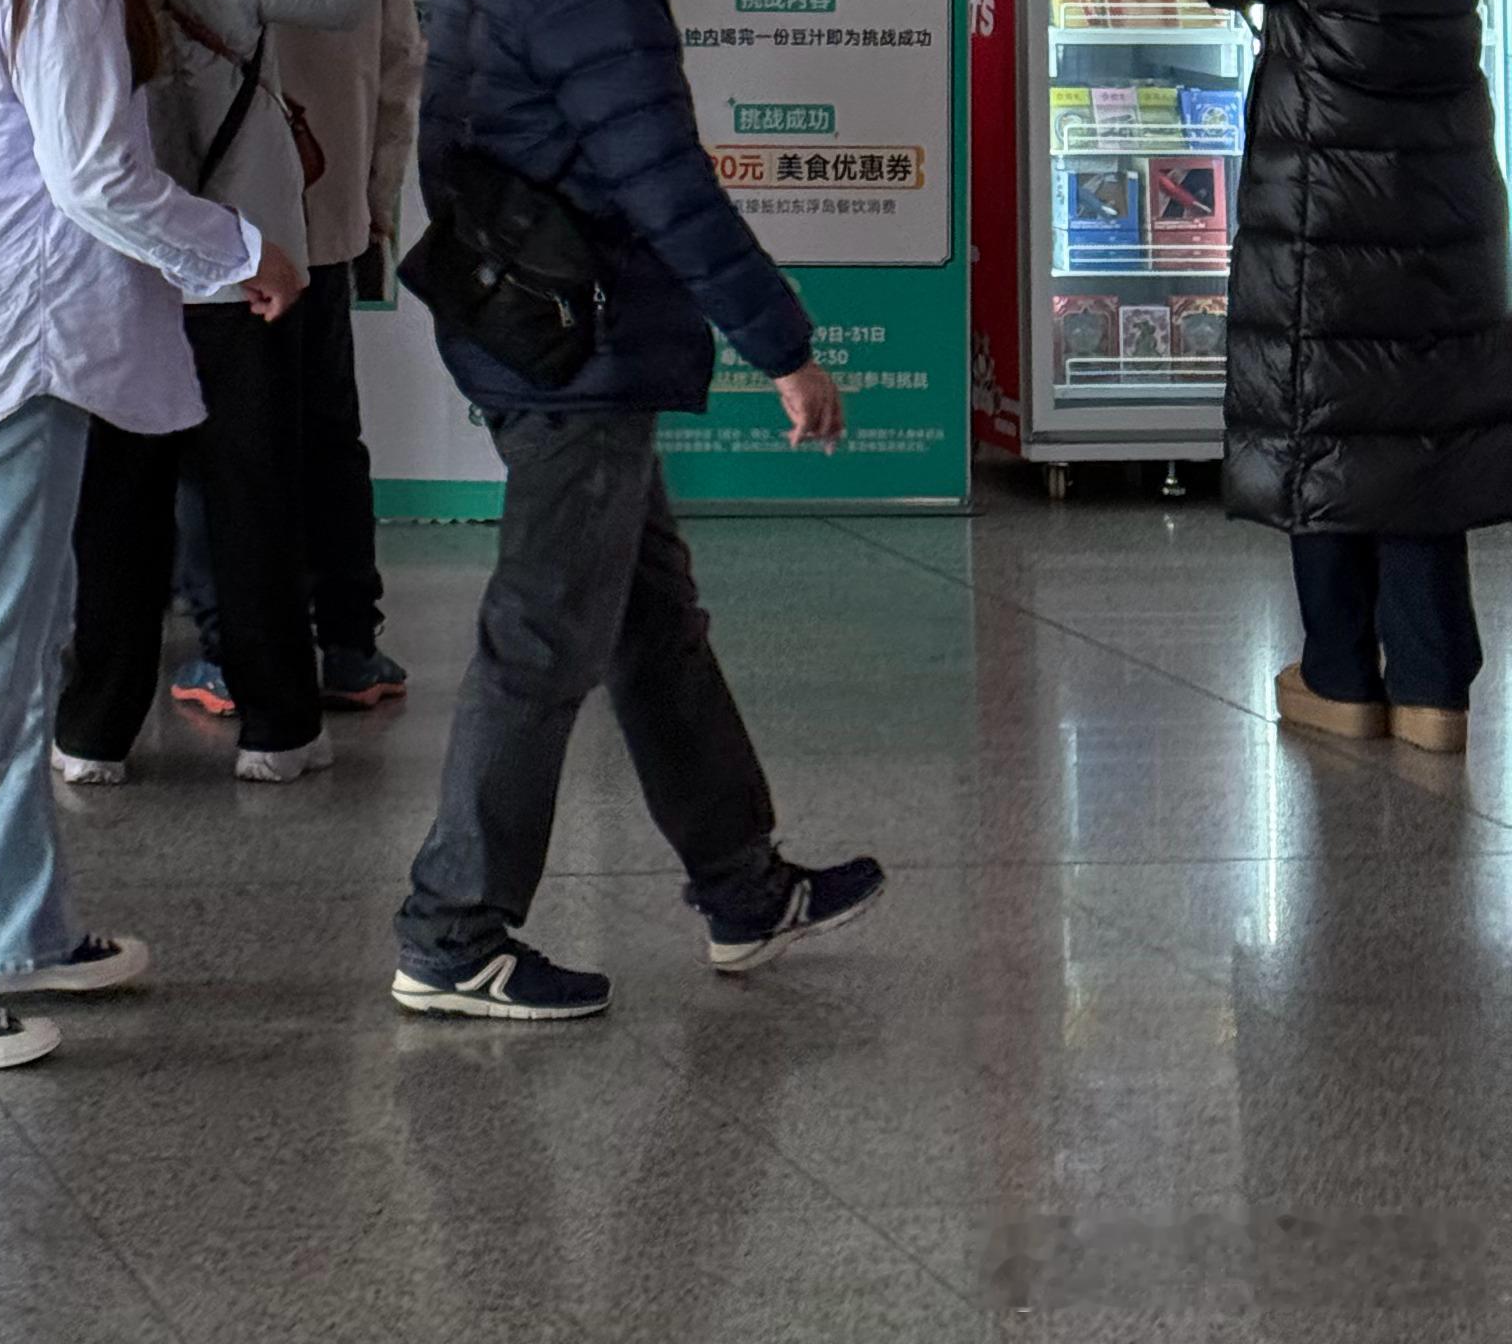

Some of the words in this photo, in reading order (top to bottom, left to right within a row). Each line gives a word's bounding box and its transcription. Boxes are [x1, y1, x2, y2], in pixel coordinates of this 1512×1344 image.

[739, 108, 829, 131] 挑战成功
[777, 153, 913, 182] 美食优惠券
[810, 326, 886, 344] 9日-31日
